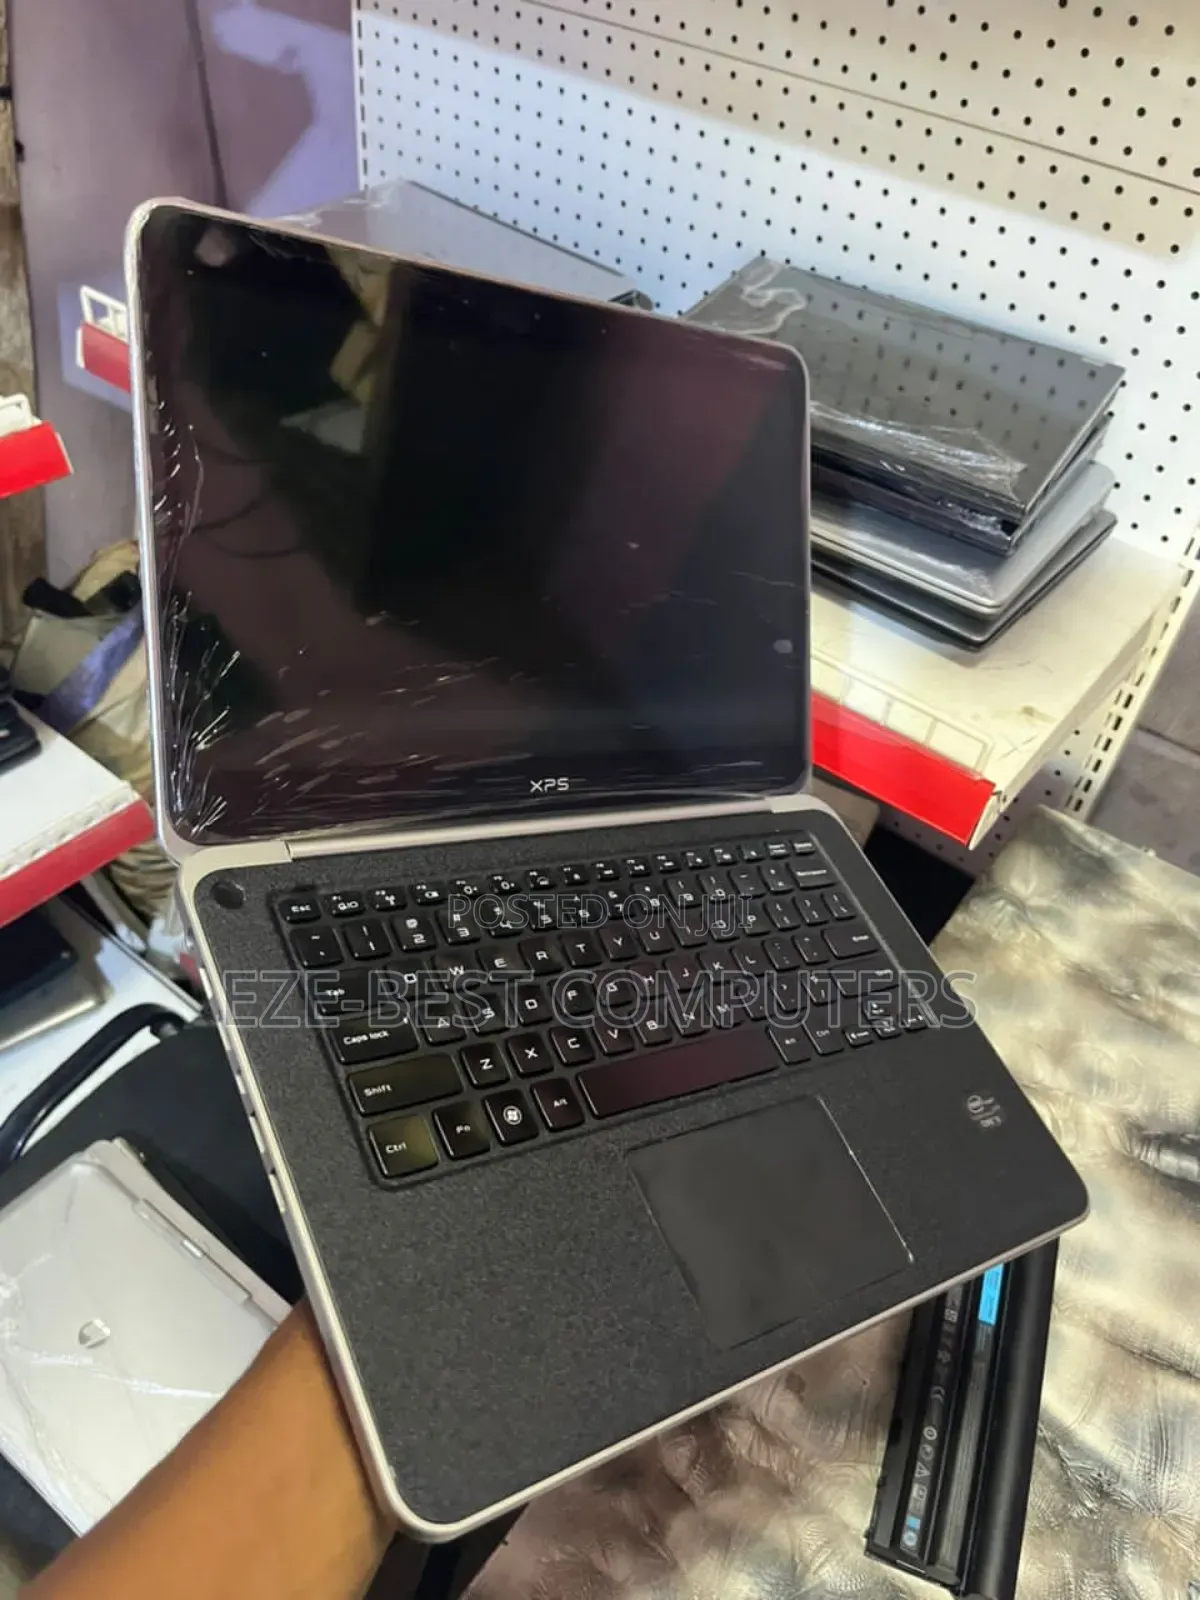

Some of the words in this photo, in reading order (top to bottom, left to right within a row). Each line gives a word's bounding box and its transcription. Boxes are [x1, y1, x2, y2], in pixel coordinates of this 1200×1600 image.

[529, 777, 570, 793] XPS
[613, 937, 623, 947] Y
[649, 931, 661, 941] U
[576, 943, 586, 953] T
[494, 958, 508, 968] E
[712, 961, 724, 971] K
[744, 955, 757, 965] L
[449, 965, 465, 976] W
[566, 989, 579, 1001] F
[481, 1006, 496, 1019] S
[607, 1028, 620, 1040] V
[566, 1037, 581, 1050] C
[523, 1046, 540, 1060] X
[479, 1057, 495, 1071] Z
[363, 1083, 393, 1097] Shift
[384, 1141, 408, 1154] Ctrl
